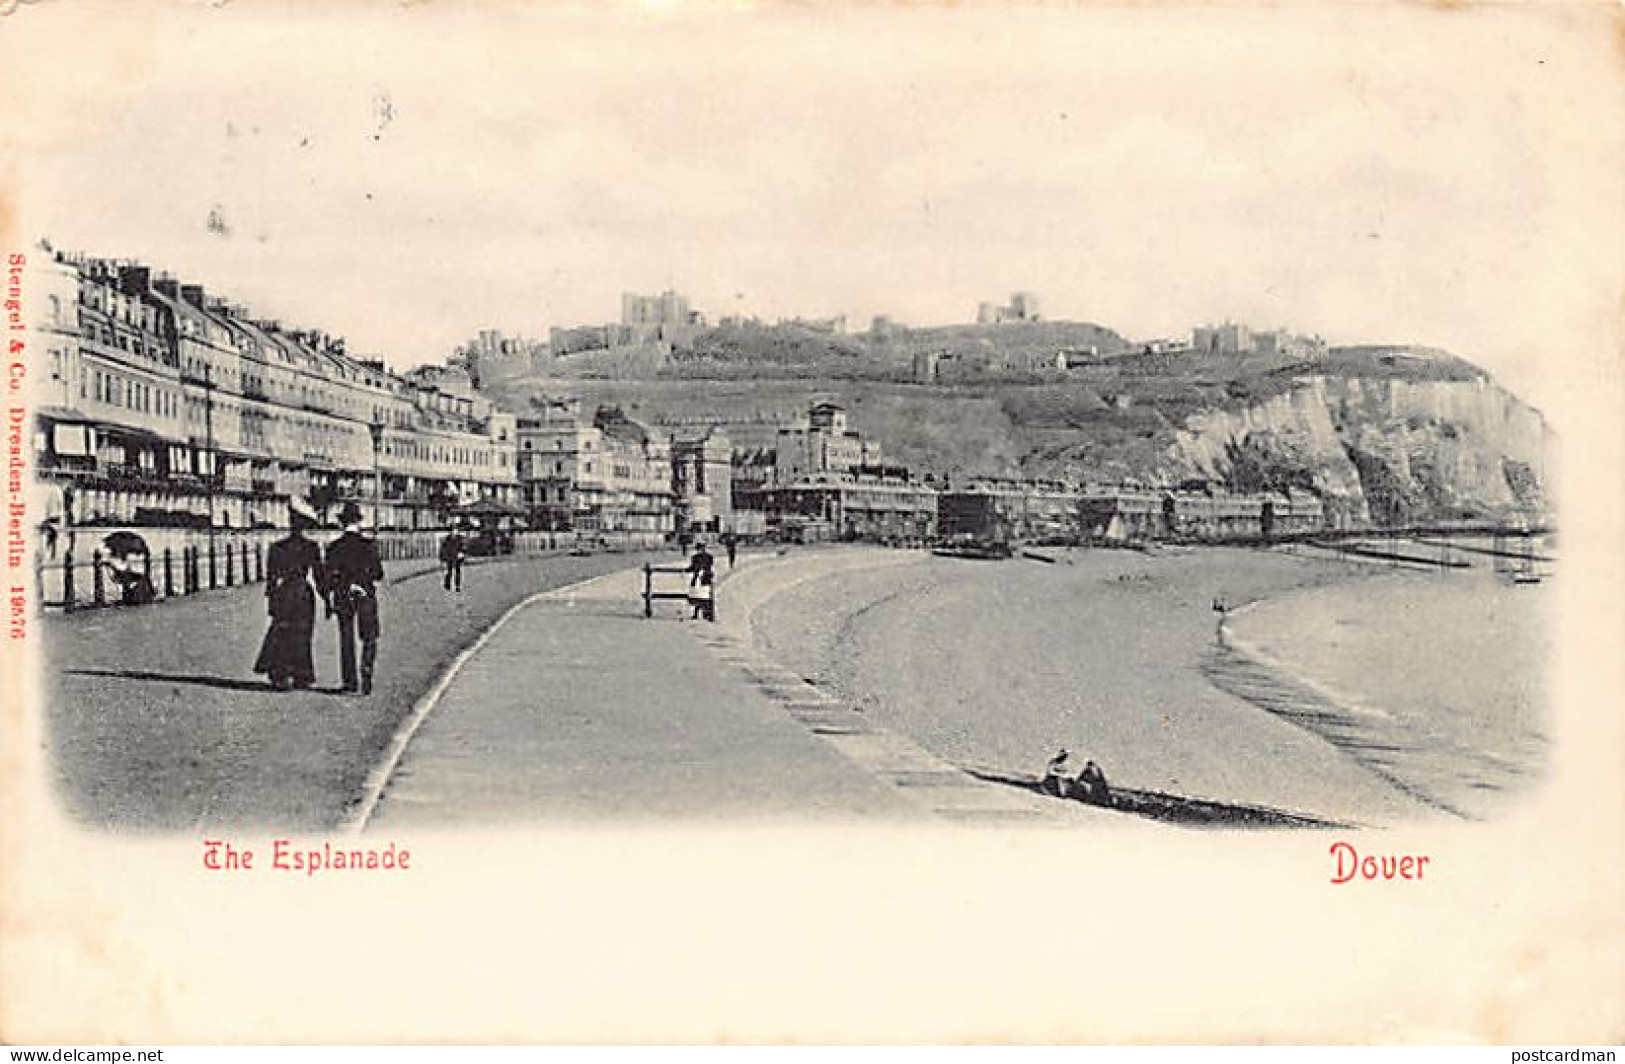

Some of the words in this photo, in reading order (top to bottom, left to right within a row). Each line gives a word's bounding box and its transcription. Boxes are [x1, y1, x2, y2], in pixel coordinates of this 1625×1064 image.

[5, 253, 25, 330] Stengel
[9, 339, 26, 353] &
[7, 407, 25, 568] Dresden-Berlin
[202, 839, 254, 870] The
[272, 839, 411, 876] Esplanade
[1329, 841, 1430, 885] Dover
